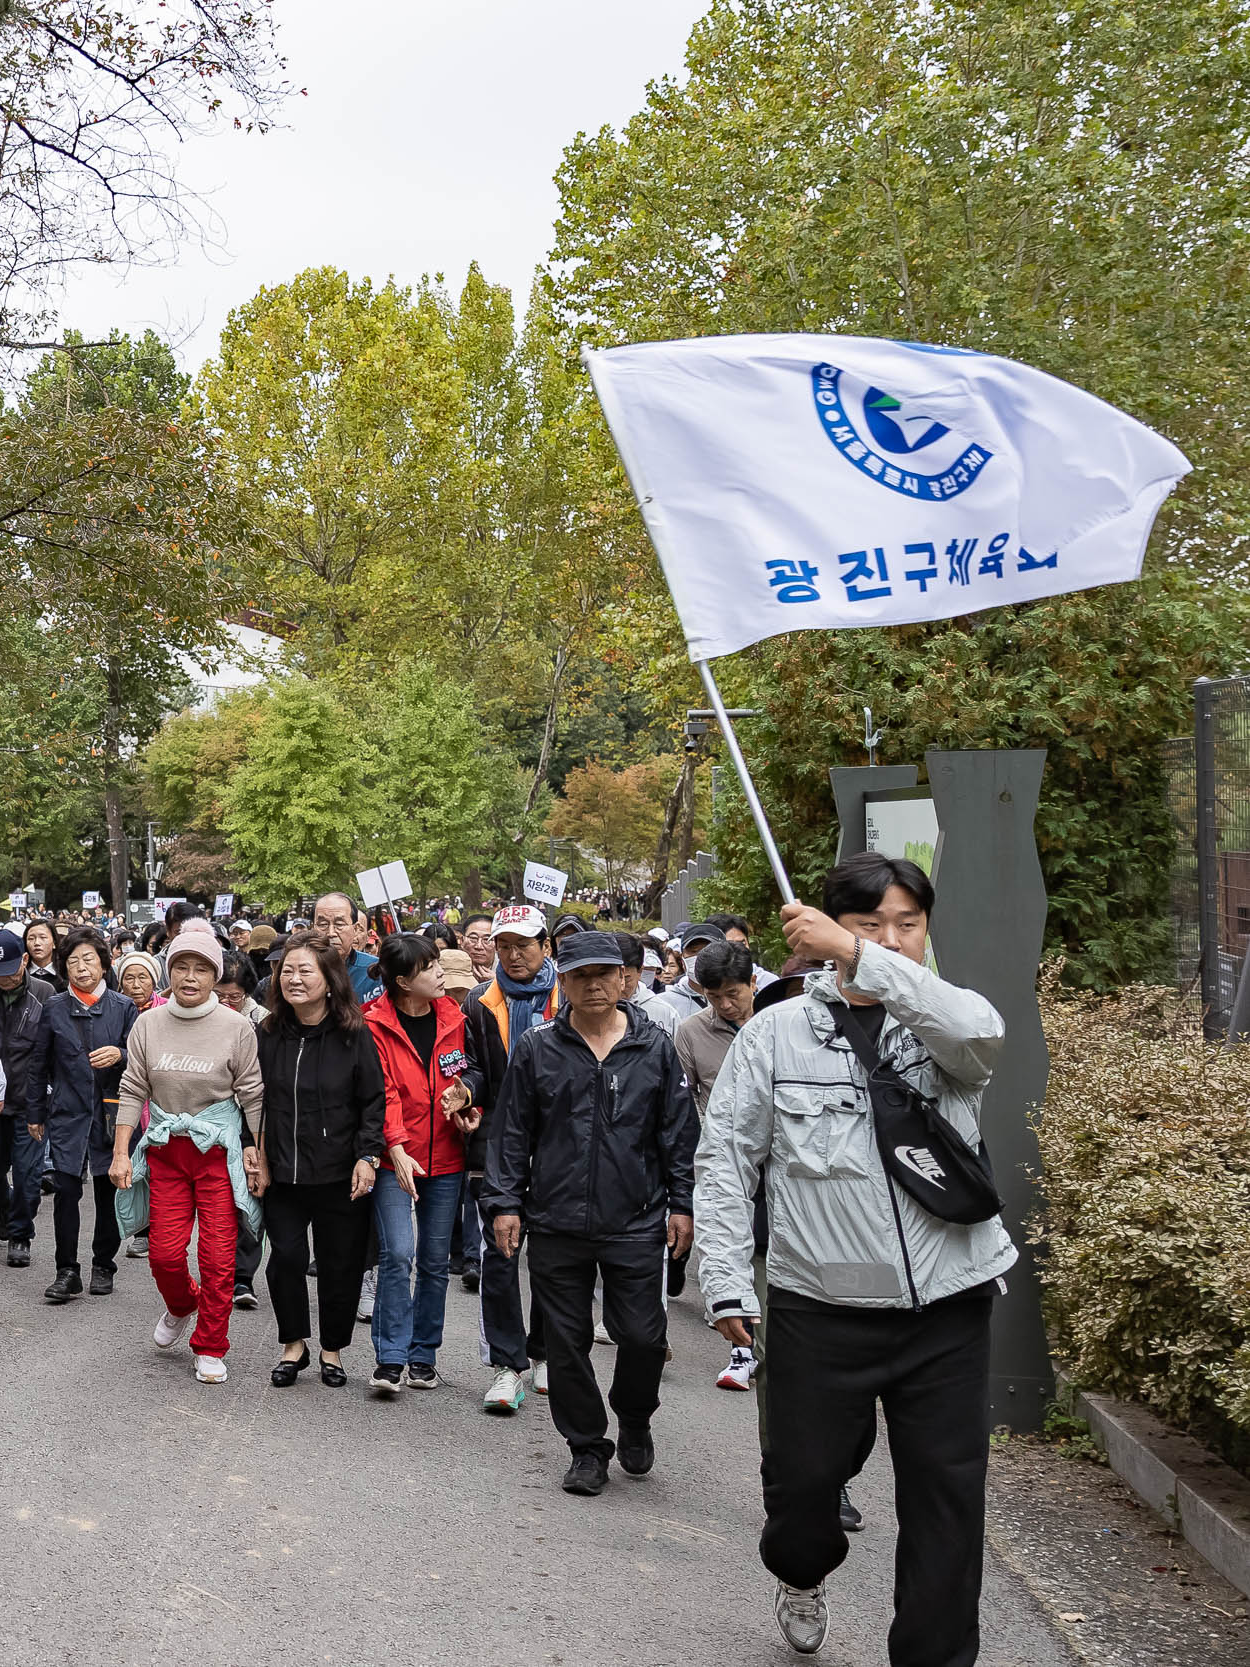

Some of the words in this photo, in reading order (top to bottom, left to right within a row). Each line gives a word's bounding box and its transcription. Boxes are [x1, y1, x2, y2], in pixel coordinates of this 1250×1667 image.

[526, 879, 559, 897] 자양2동
[496, 906, 530, 921] JEEP
[152, 1053, 215, 1074] Mellow
[909, 1147, 946, 1180] NIKE
